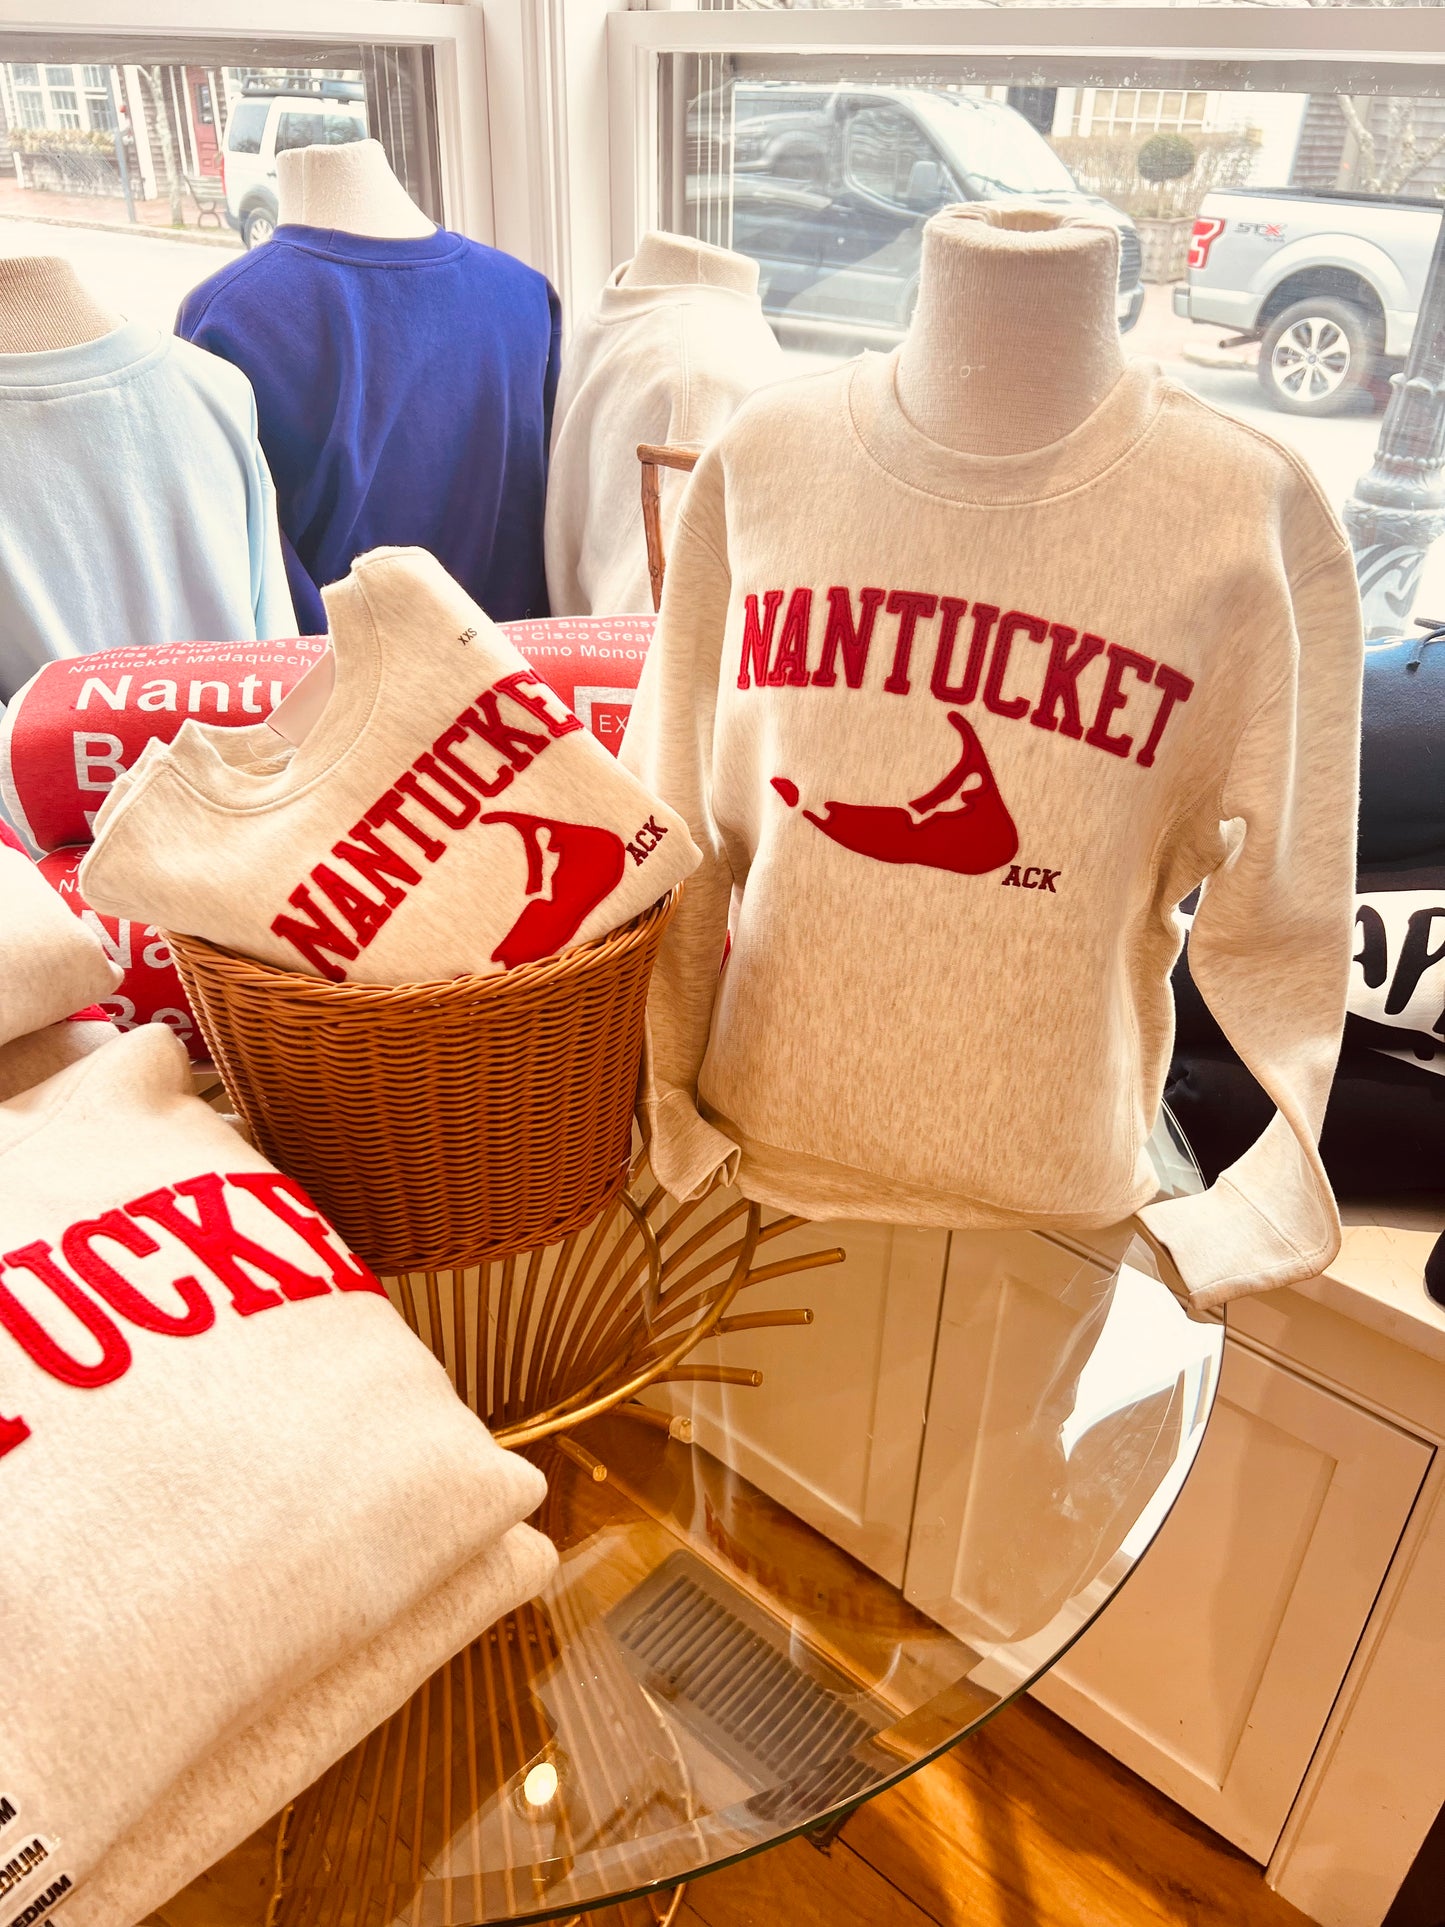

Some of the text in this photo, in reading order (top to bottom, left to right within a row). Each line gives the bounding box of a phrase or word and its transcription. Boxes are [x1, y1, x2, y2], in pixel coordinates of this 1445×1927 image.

[456, 626, 479, 647] XXS
[531, 631, 590, 641] Cisco
[597, 631, 654, 643] Great
[68, 652, 312, 674] Nantucket Madaquech
[77, 651, 148, 664] Jetties
[736, 586, 1195, 768] NANTUCKET
[271, 667, 585, 983] NANTUCKE
[625, 814, 669, 867] ACK
[1000, 865, 1062, 893] ACK
